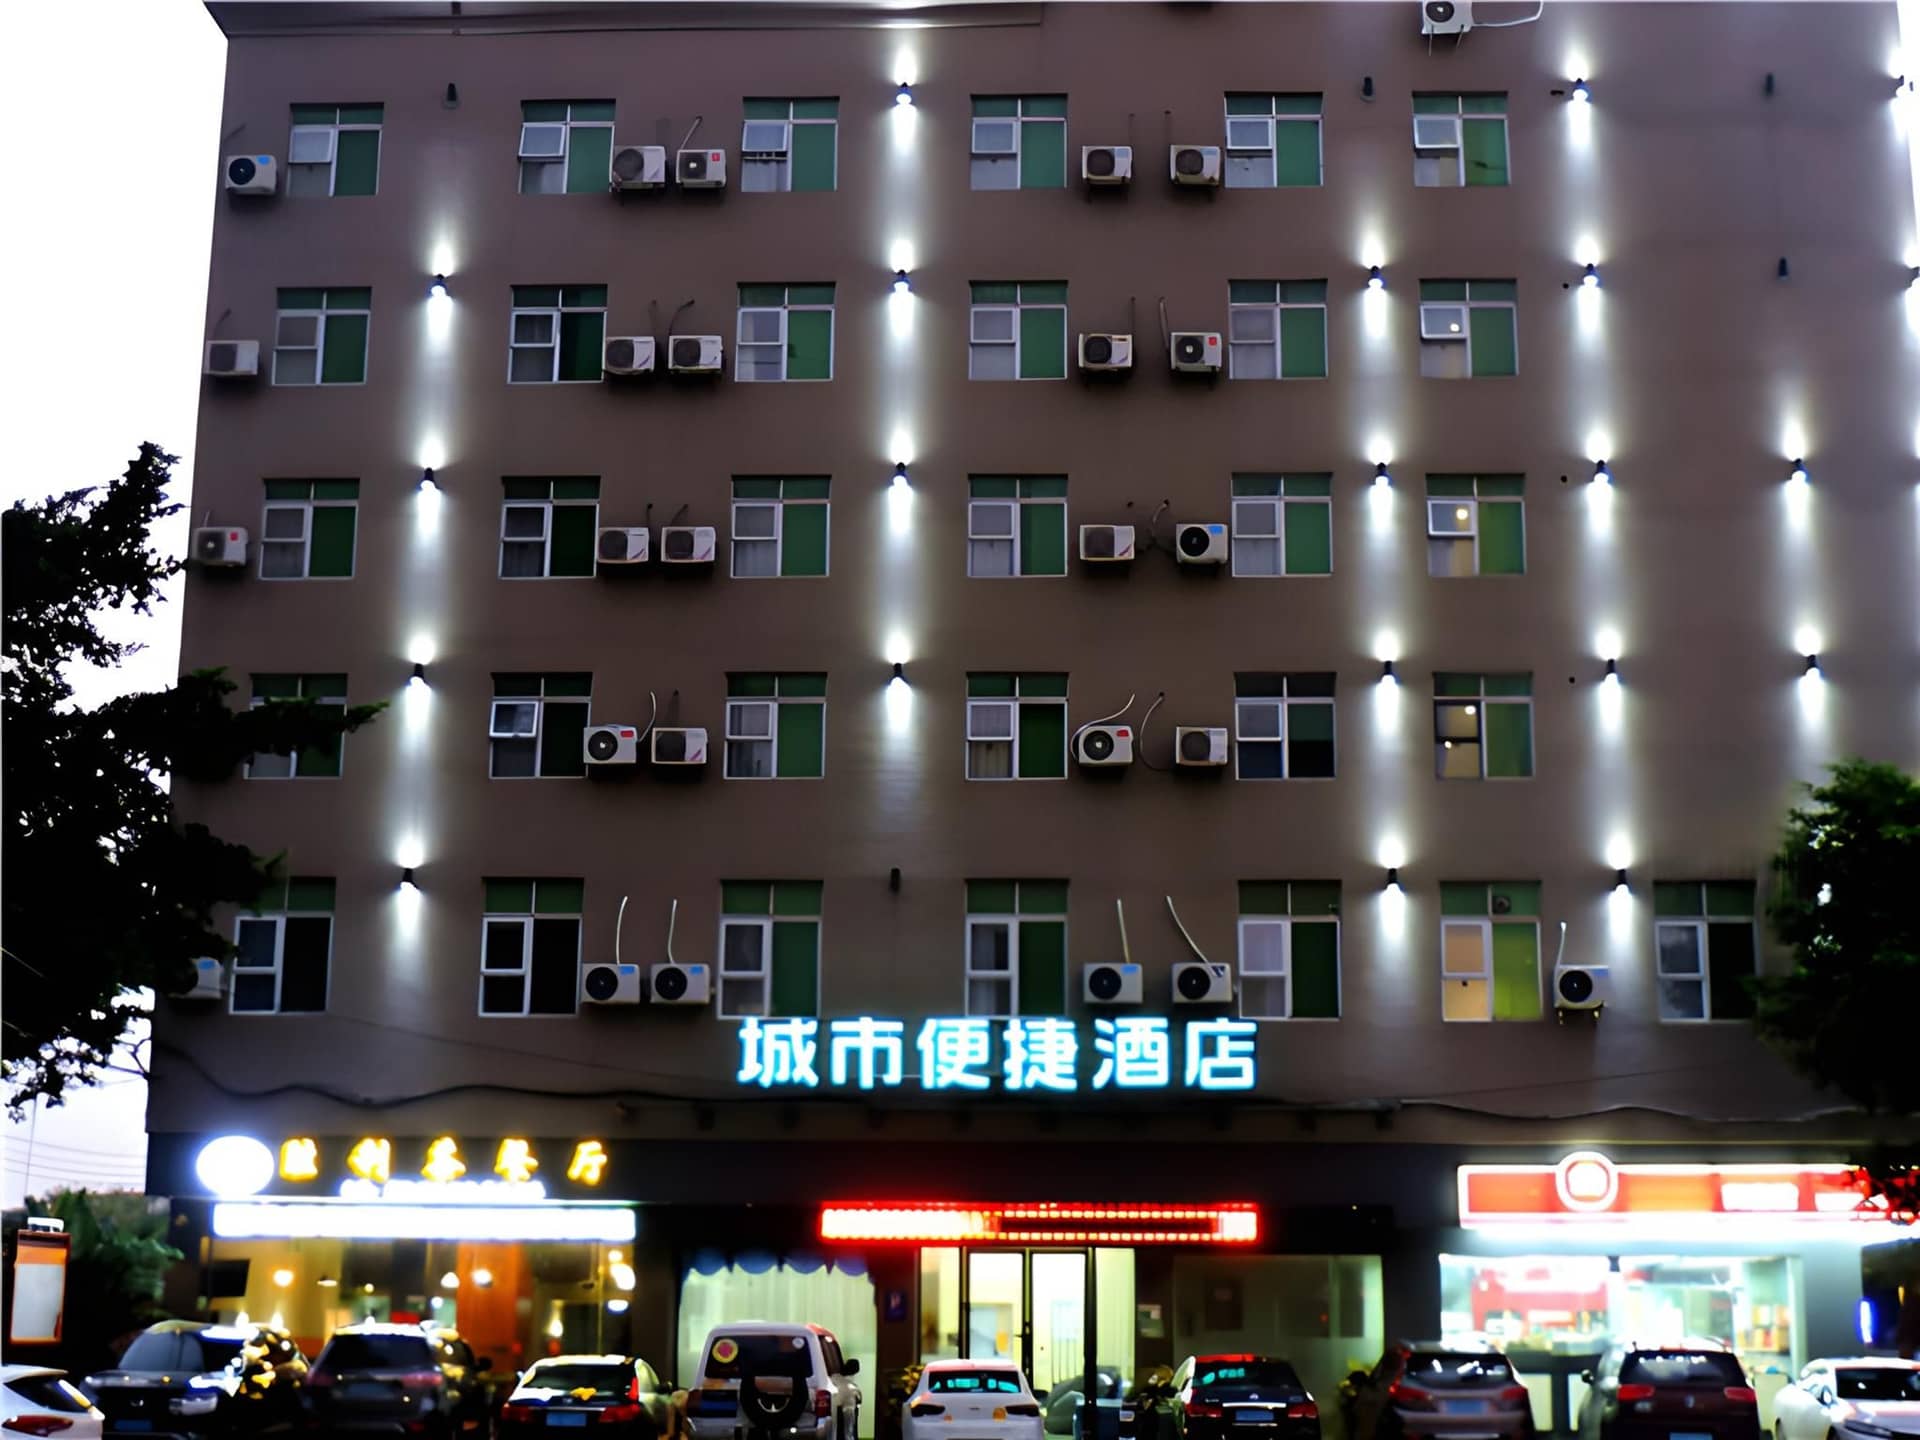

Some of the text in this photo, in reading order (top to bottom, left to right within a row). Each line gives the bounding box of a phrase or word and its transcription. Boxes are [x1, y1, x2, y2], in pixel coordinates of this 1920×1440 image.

[737, 1017, 1258, 1091] 城市便捷酒店
